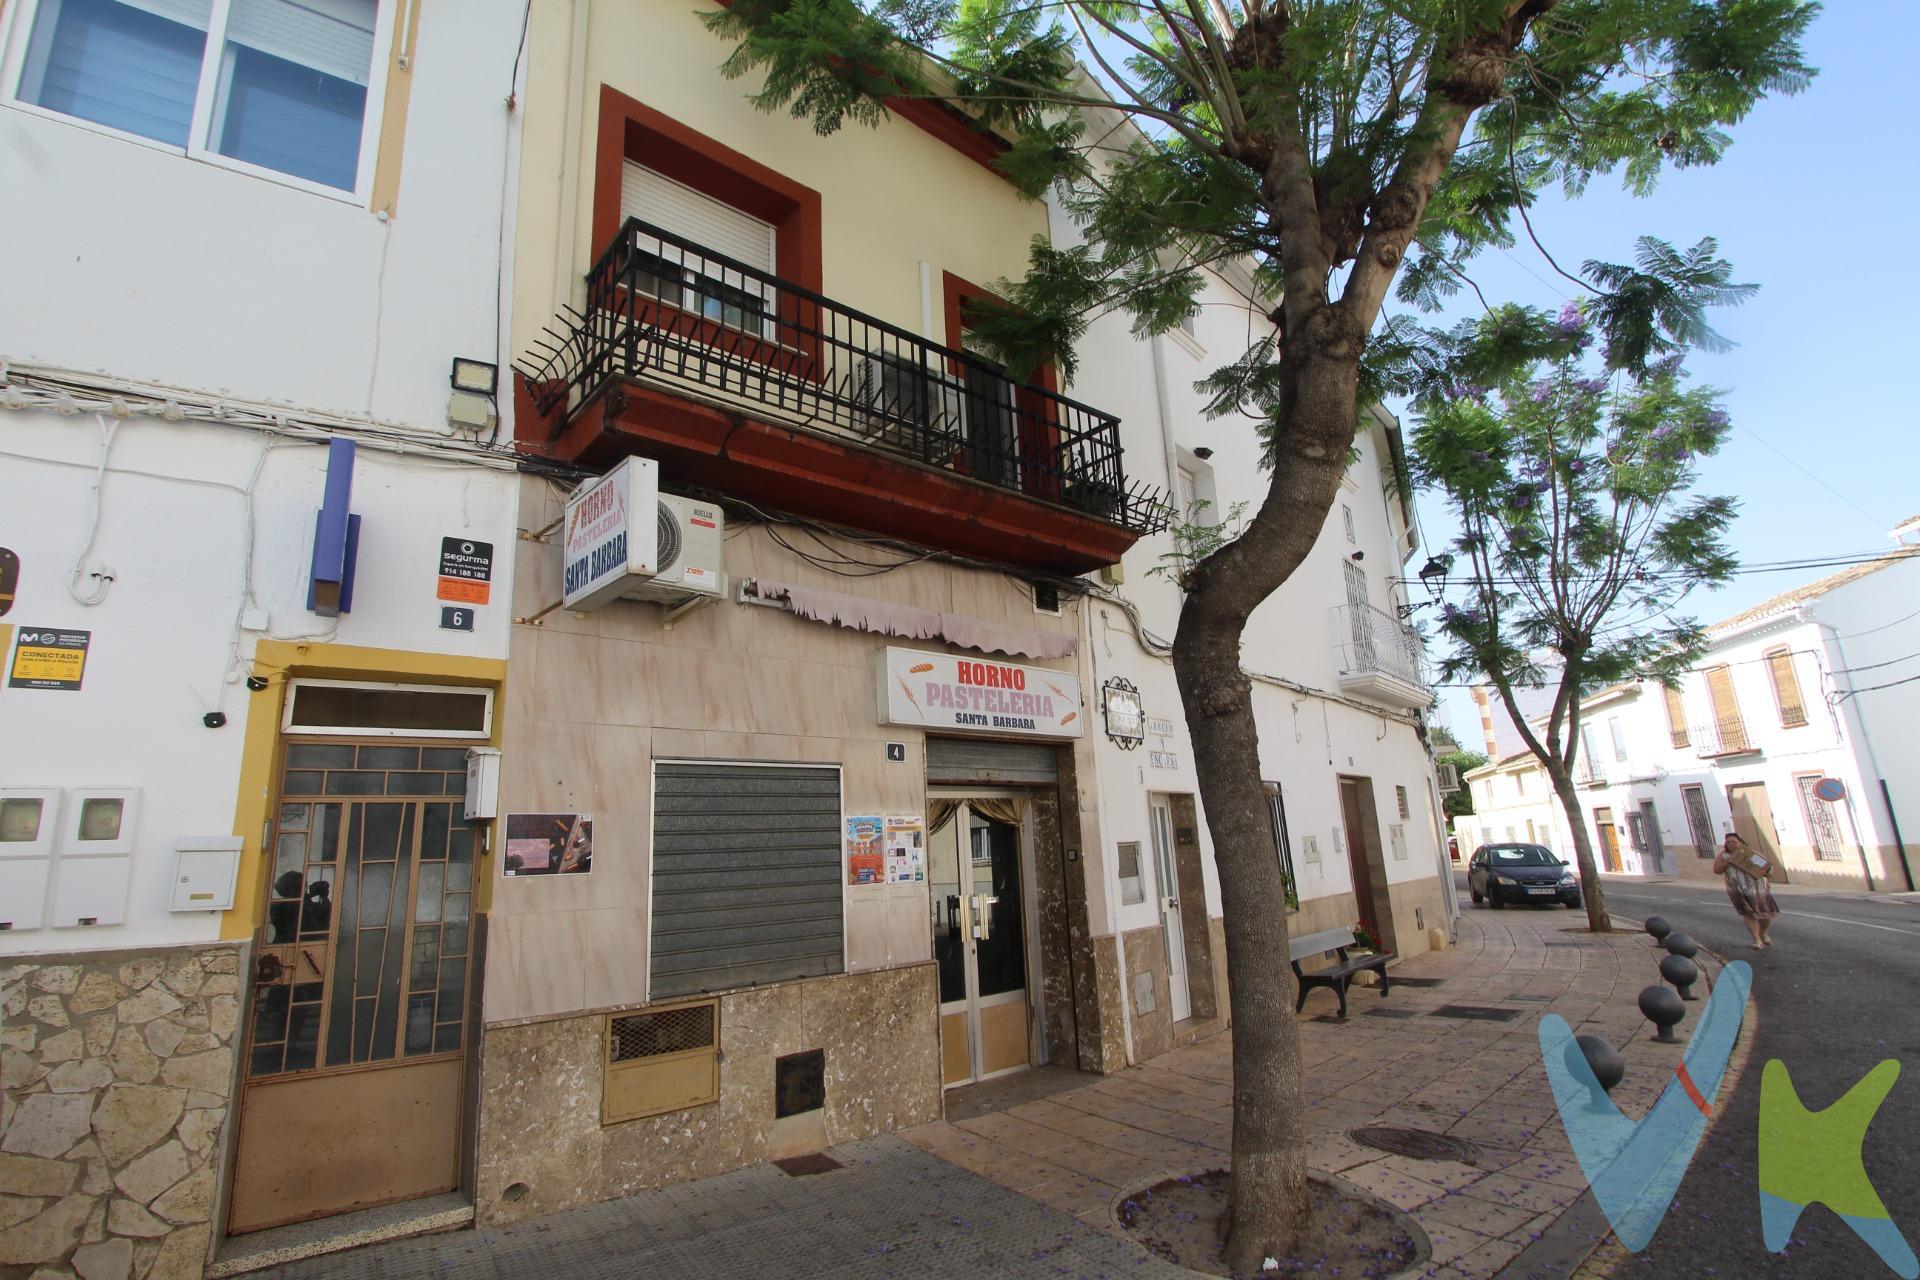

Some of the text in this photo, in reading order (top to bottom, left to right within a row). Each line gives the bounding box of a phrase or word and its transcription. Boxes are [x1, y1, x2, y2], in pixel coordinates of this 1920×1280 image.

[580, 480, 614, 530] HORNO
[572, 509, 621, 552] PASTELERIA
[444, 552, 489, 565] segurma
[565, 531, 628, 596] SANTA BARBARA
[444, 567, 457, 575] 914
[453, 611, 462, 626] 6
[22, 651, 79, 660] CONECTADA
[957, 660, 1026, 691] HORNO
[925, 682, 1055, 718] PASTELERIA
[955, 712, 1036, 730] SANTA BARBARA
[893, 746, 899, 759] 4
